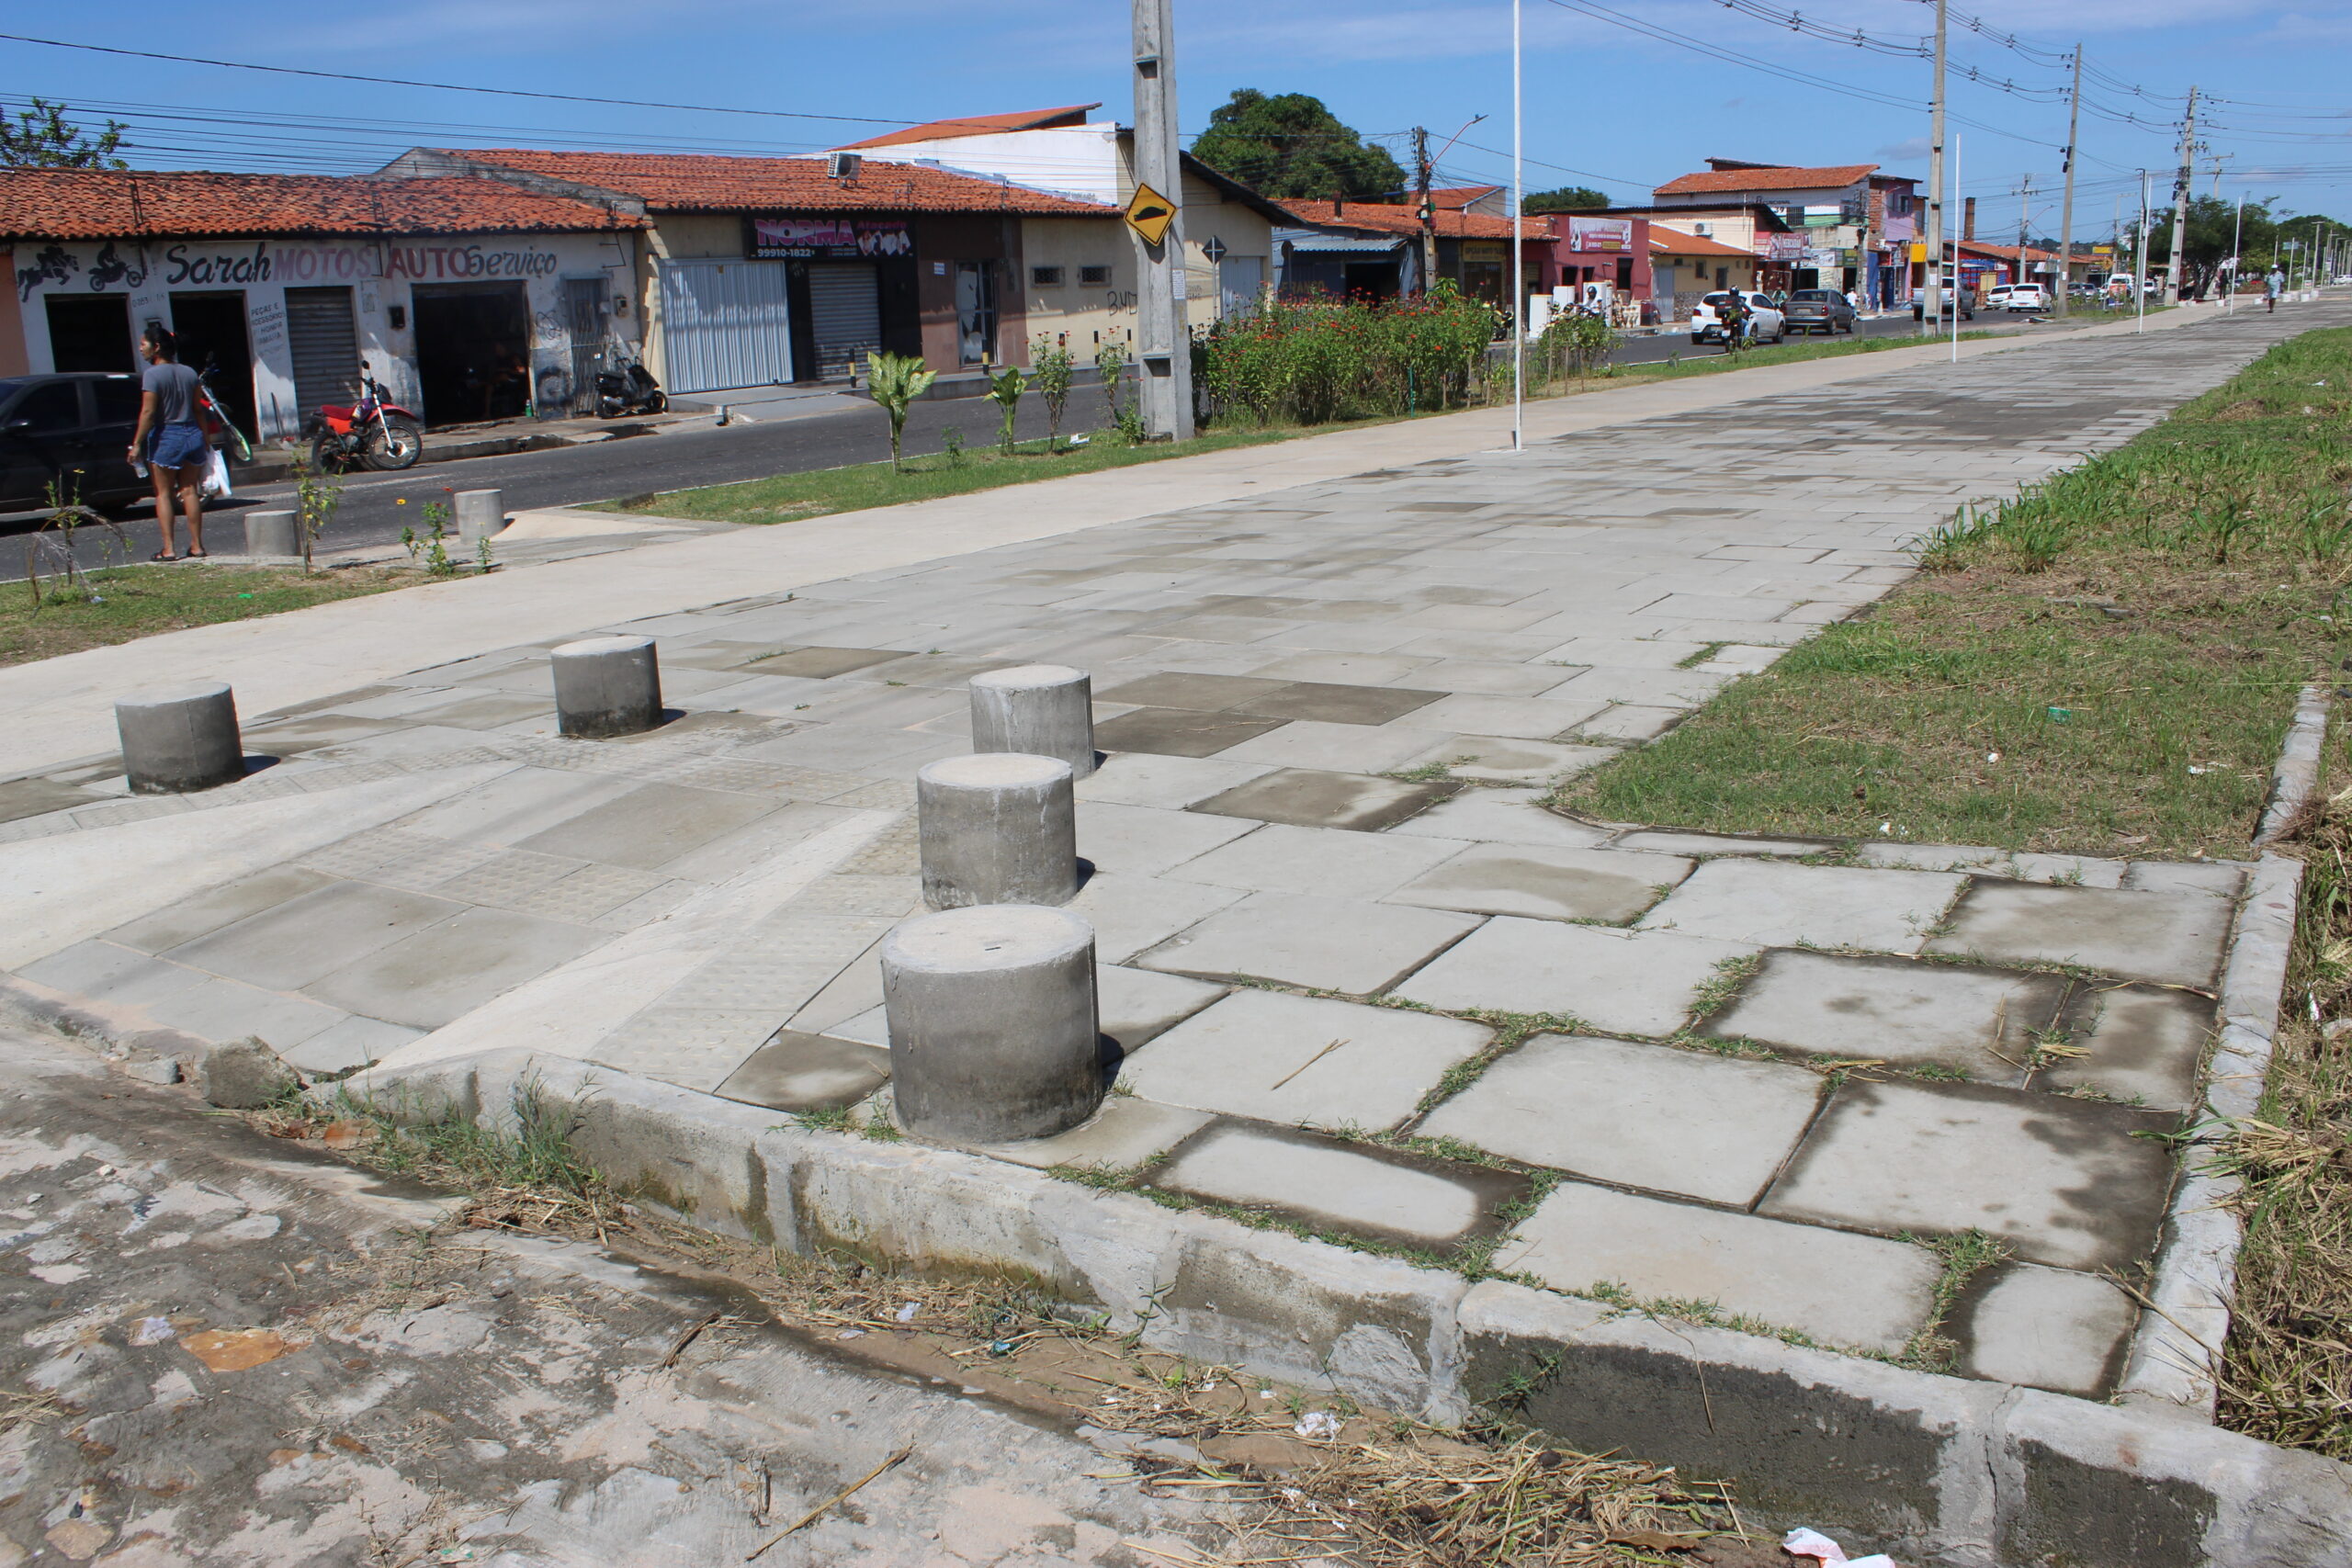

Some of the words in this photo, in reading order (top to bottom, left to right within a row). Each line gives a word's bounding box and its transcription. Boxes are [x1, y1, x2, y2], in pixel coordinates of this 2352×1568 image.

[755, 220, 855, 245] NORMA
[757, 249, 811, 257] 99910-1822
[165, 242, 270, 283] Sarah
[273, 247, 370, 280] MOTOS
[384, 247, 469, 279] AUTO
[467, 244, 556, 278] Serviço
[251, 304, 272, 316] PEÇAS
